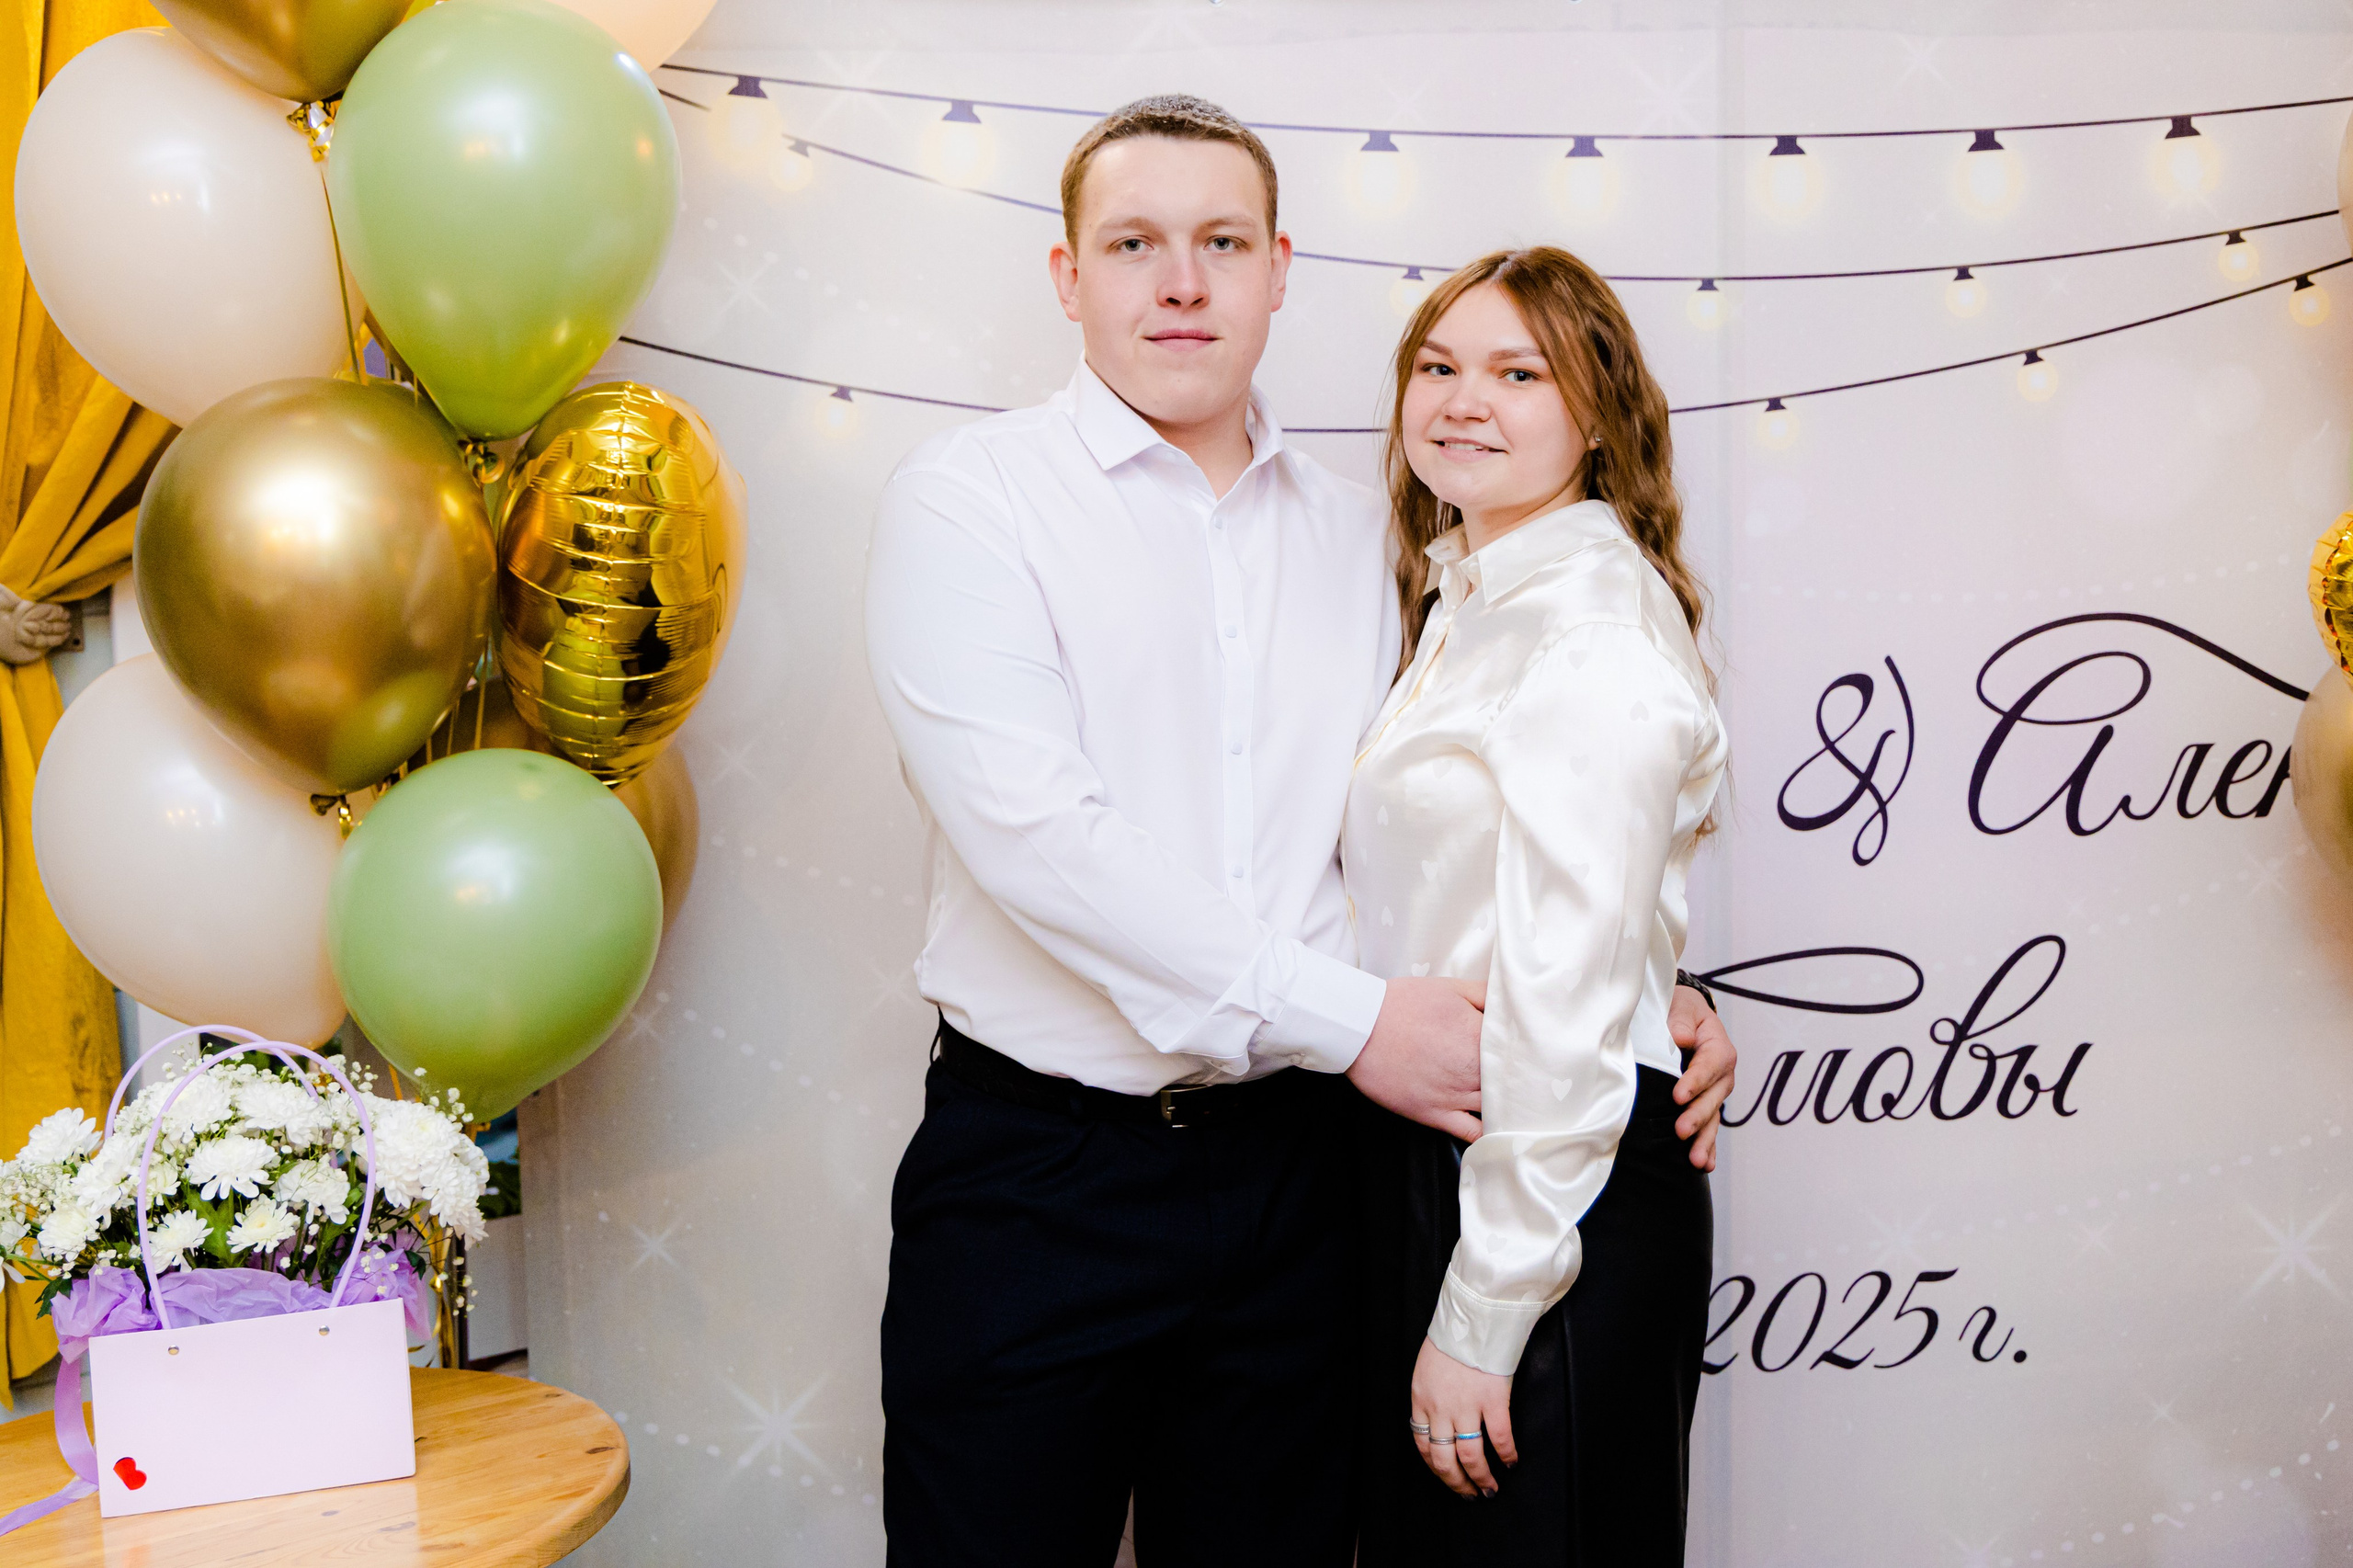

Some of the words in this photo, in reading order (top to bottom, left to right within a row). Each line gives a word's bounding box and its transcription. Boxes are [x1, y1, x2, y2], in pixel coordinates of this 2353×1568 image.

[1700, 935, 2093, 1128] мовы
[1700, 1267, 1959, 1375] 2025
[1958, 1305, 2028, 1364] г.
